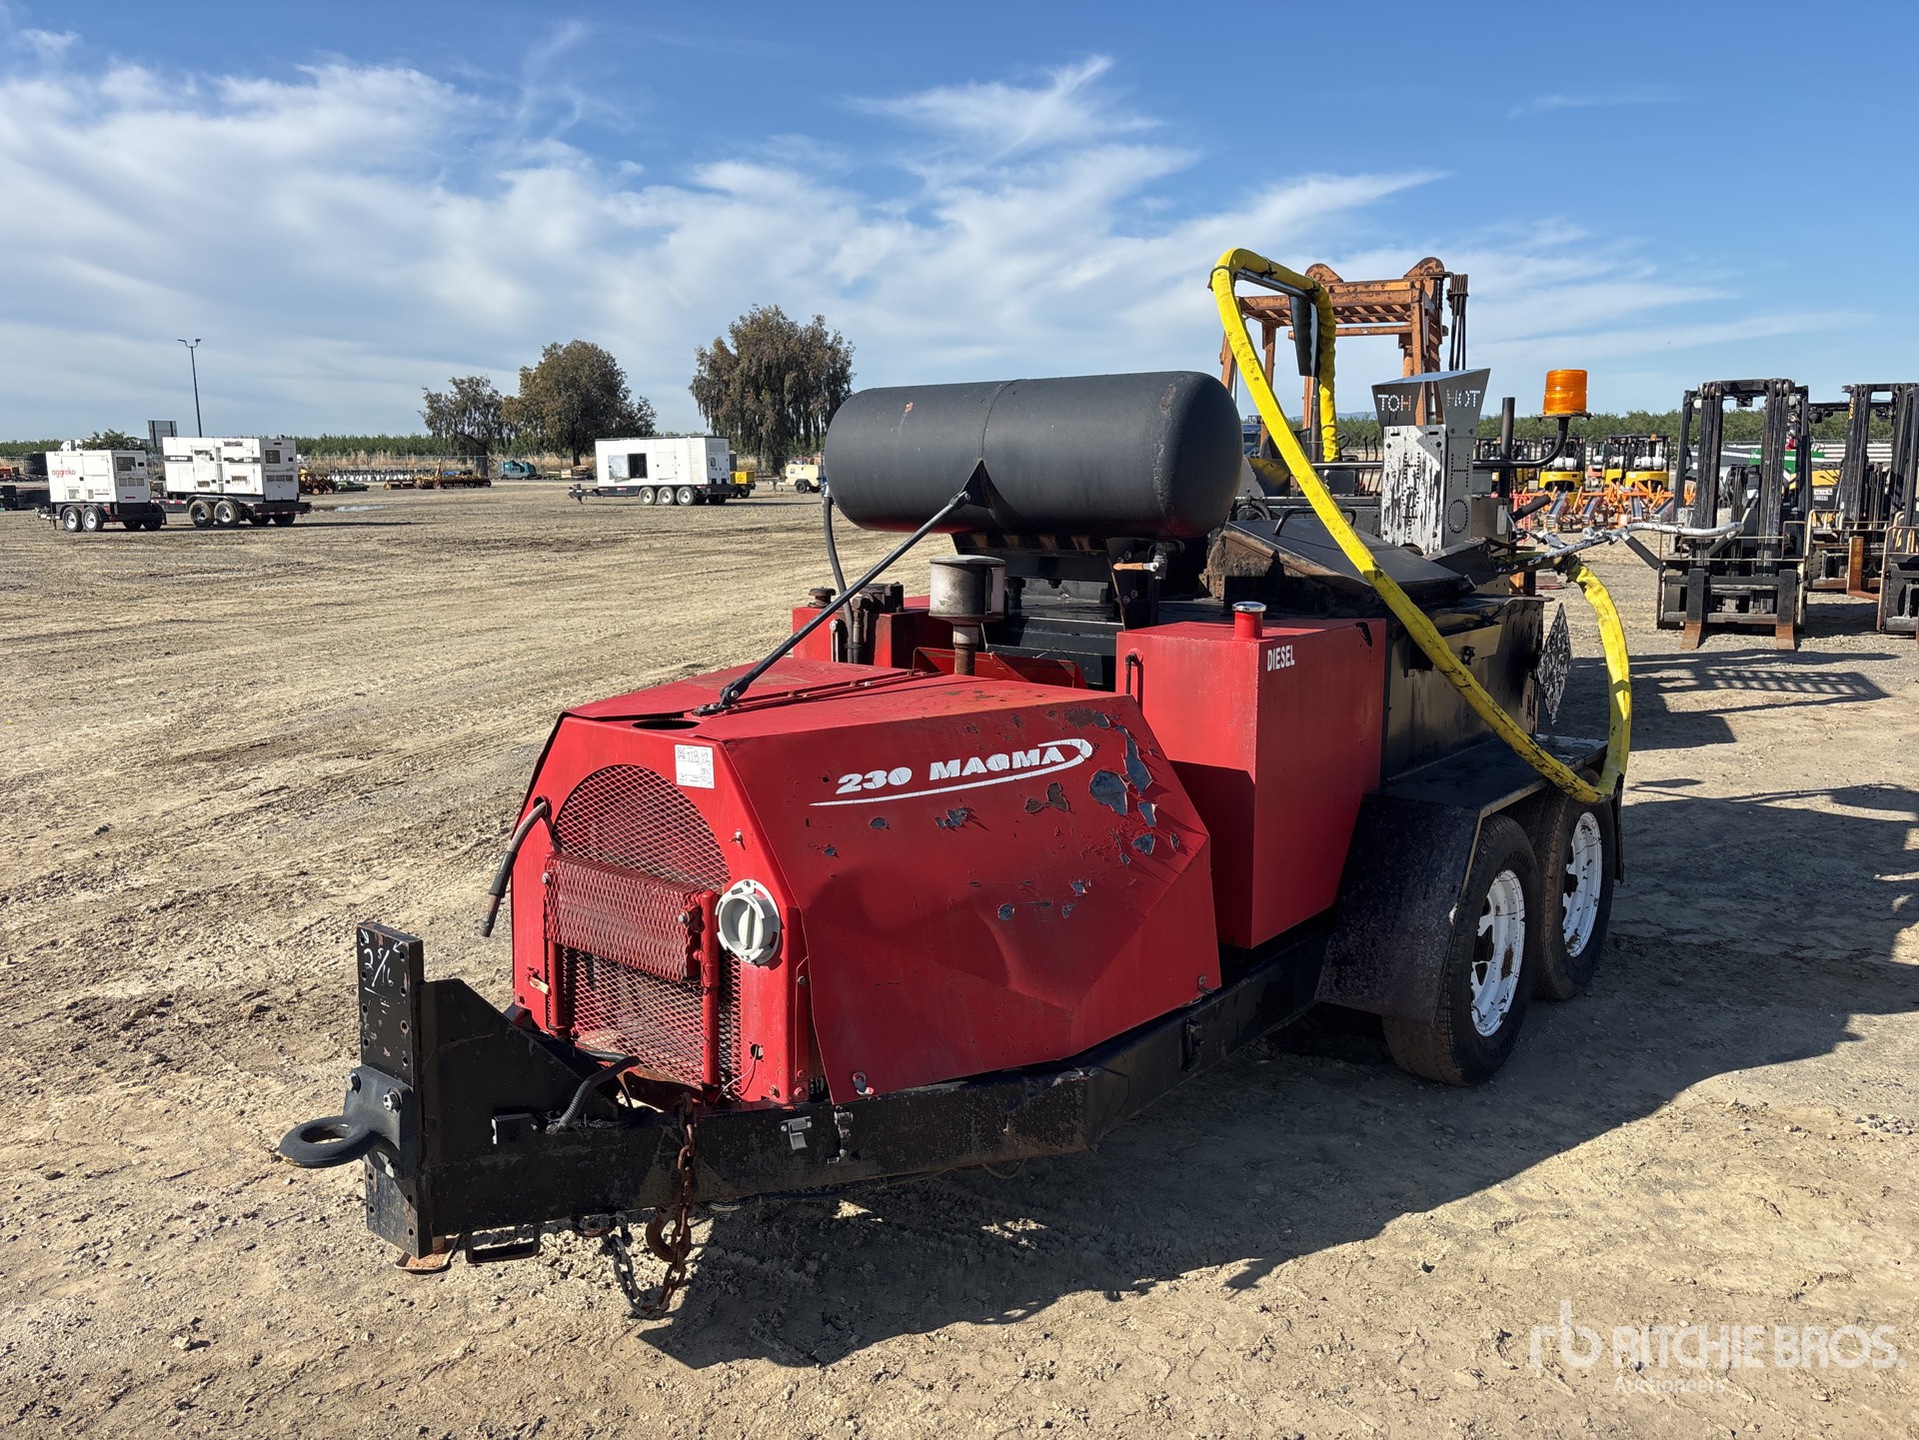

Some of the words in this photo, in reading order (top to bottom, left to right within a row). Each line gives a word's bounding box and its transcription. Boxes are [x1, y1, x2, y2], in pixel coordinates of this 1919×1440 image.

[1446, 388, 1481, 407] HOT
[52, 467, 76, 478] aggreko
[1266, 644, 1296, 672] DIESEL
[835, 766, 913, 795] 230
[929, 746, 1066, 781] MAGMA
